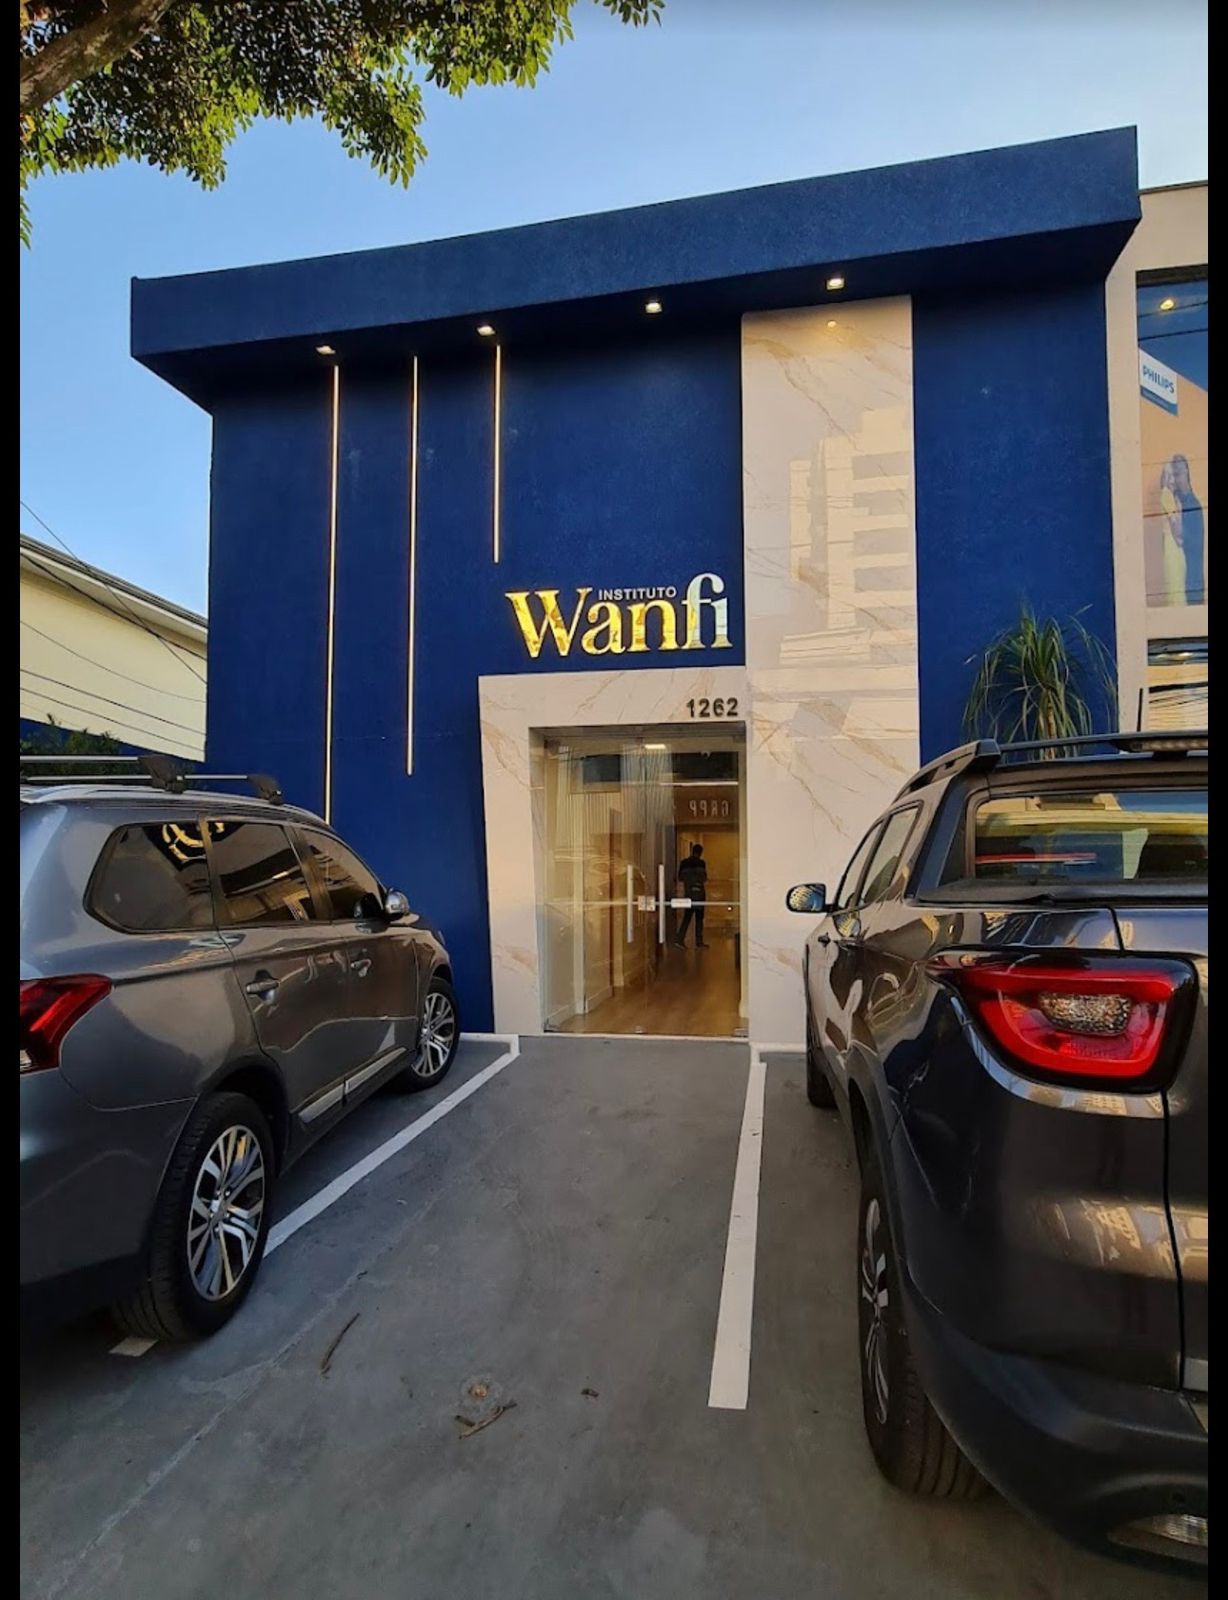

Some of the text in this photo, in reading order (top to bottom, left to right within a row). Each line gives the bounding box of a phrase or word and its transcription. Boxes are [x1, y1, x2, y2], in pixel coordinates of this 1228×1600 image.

[1142, 365, 1175, 394] PHILIPS
[598, 586, 677, 601] INSTITUTO
[504, 572, 733, 659] Wanfi
[685, 697, 739, 718] 1262
